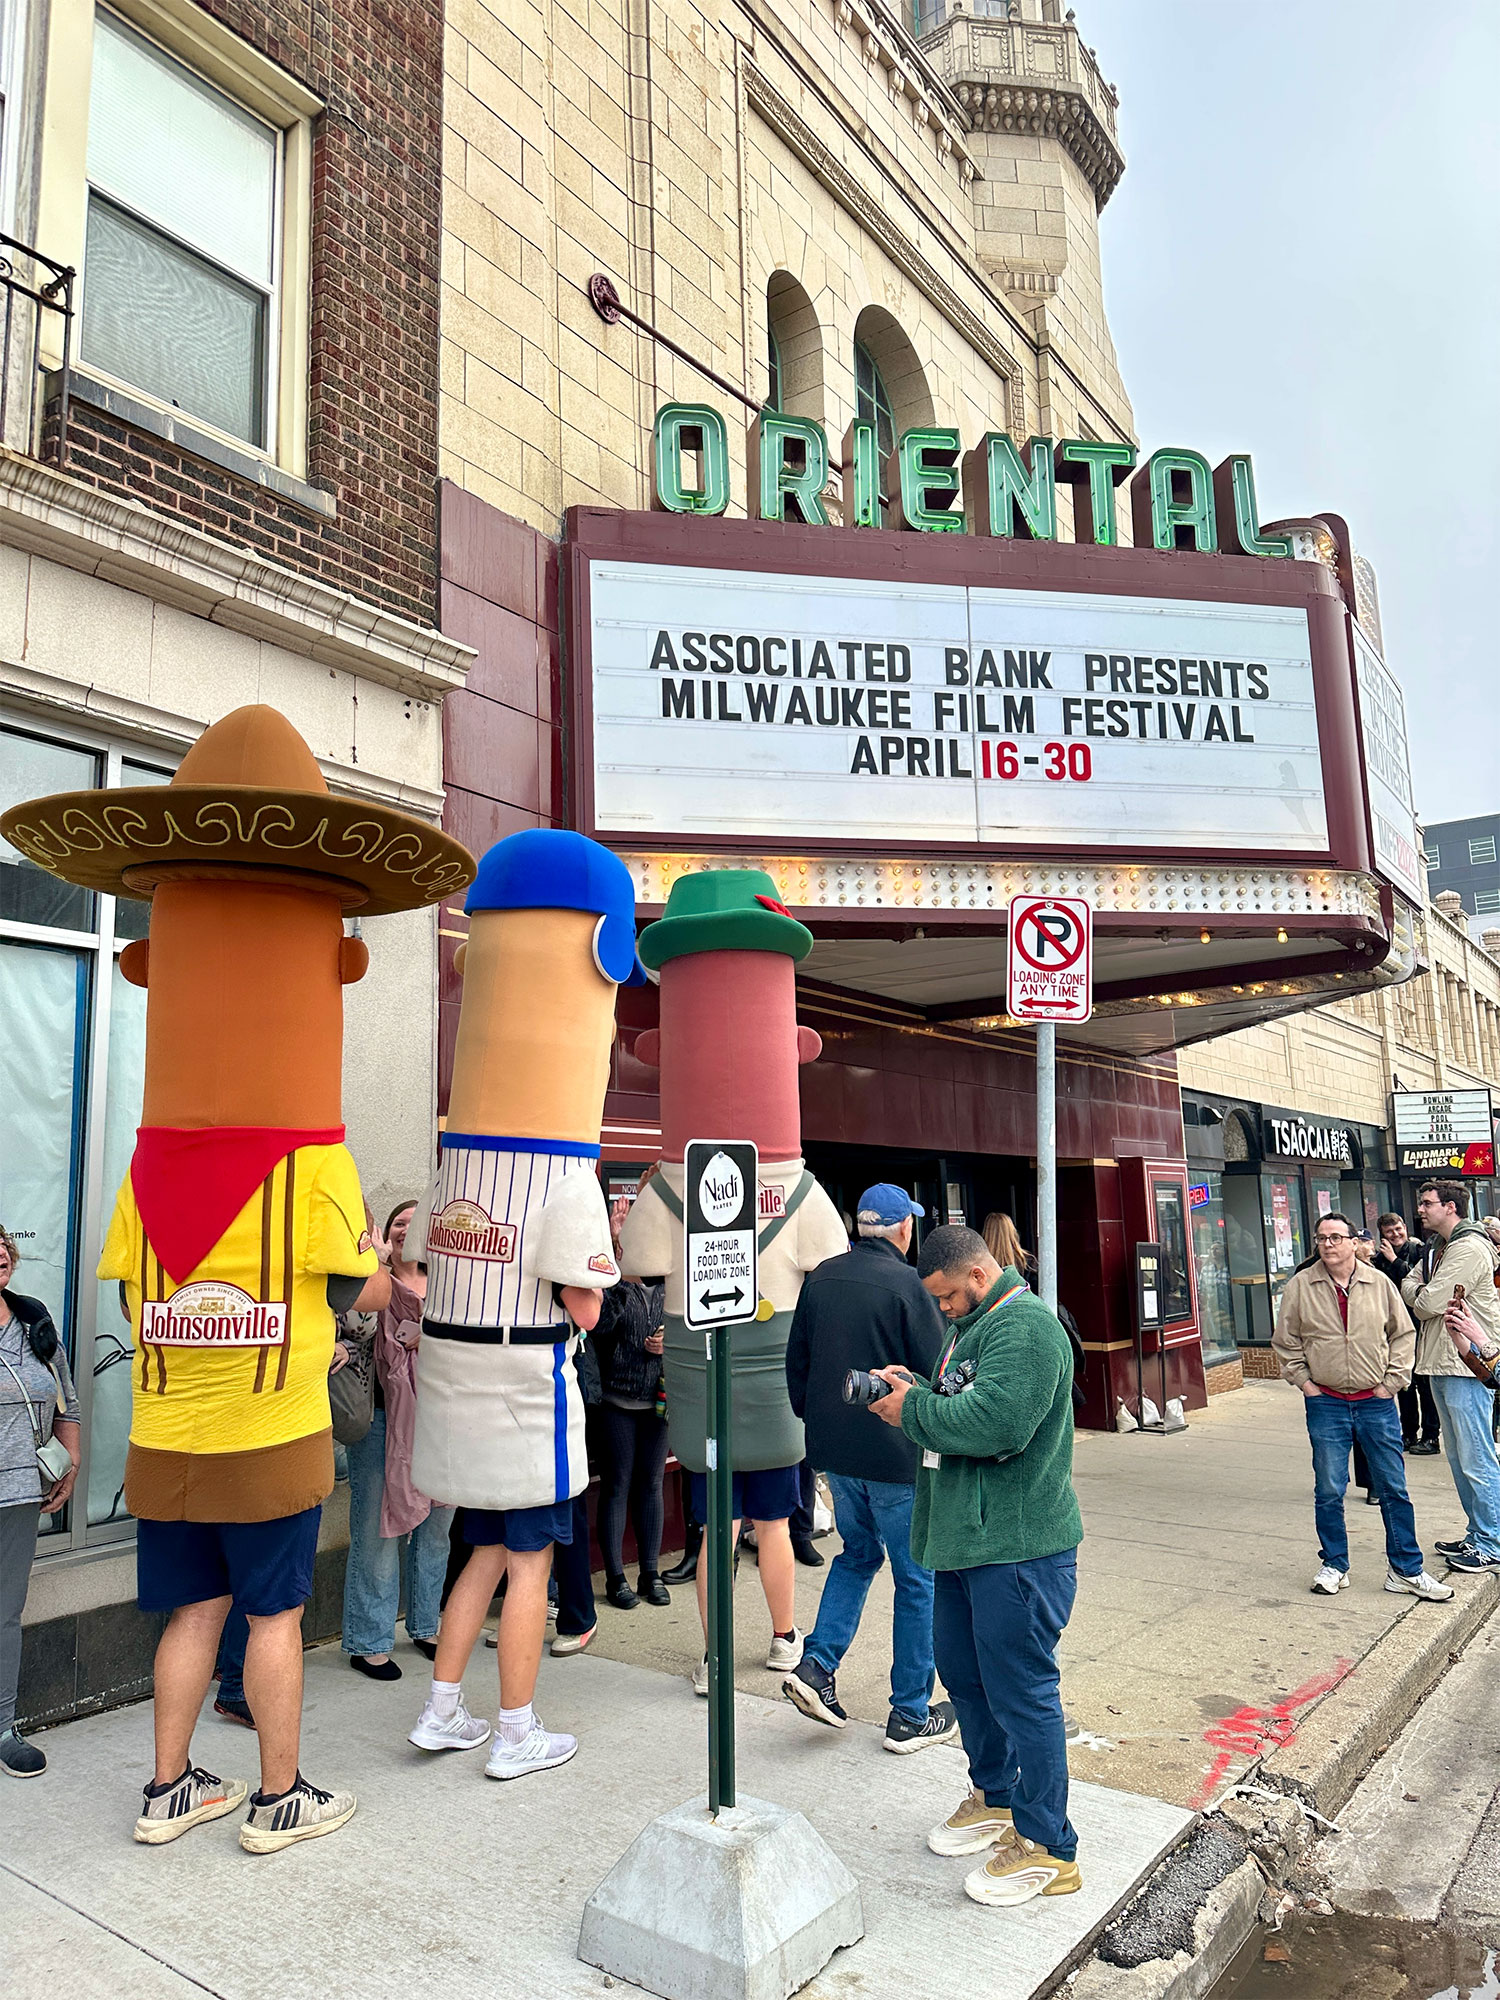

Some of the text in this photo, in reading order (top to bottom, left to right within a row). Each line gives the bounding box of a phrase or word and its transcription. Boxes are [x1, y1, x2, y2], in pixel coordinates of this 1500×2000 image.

[651, 403, 1295, 558] ORIENTAL
[649, 629, 1270, 701] ASSOCIATED BANK PRESENTS
[661, 677, 1255, 743] MILWAUKEE FILM FESTIVAL
[849, 735, 1093, 782] APRIL 16-30
[1013, 970, 1086, 986] LOADING ZONE
[1019, 983, 1080, 998] ANY TIME
[1423, 1095, 1454, 1104] BOWLING
[1428, 1105, 1452, 1114] ARCADE
[1431, 1115, 1449, 1123] POOL
[1403, 1147, 1459, 1166] LANDMARK
[1415, 1157, 1449, 1169] LANES
[1189, 1187, 1208, 1205] PEN
[712, 1201, 732, 1210] PLATES
[429, 1217, 509, 1256] Johnsonville
[704, 1239, 740, 1252] 24-HOUR
[697, 1252, 746, 1268] FOOD TRUCK
[693, 1265, 751, 1282] LOADING ZONE
[193, 1286, 216, 1294] OWNED
[217, 1287, 234, 1297] SINCE
[145, 1304, 280, 1340] Johnsonville
